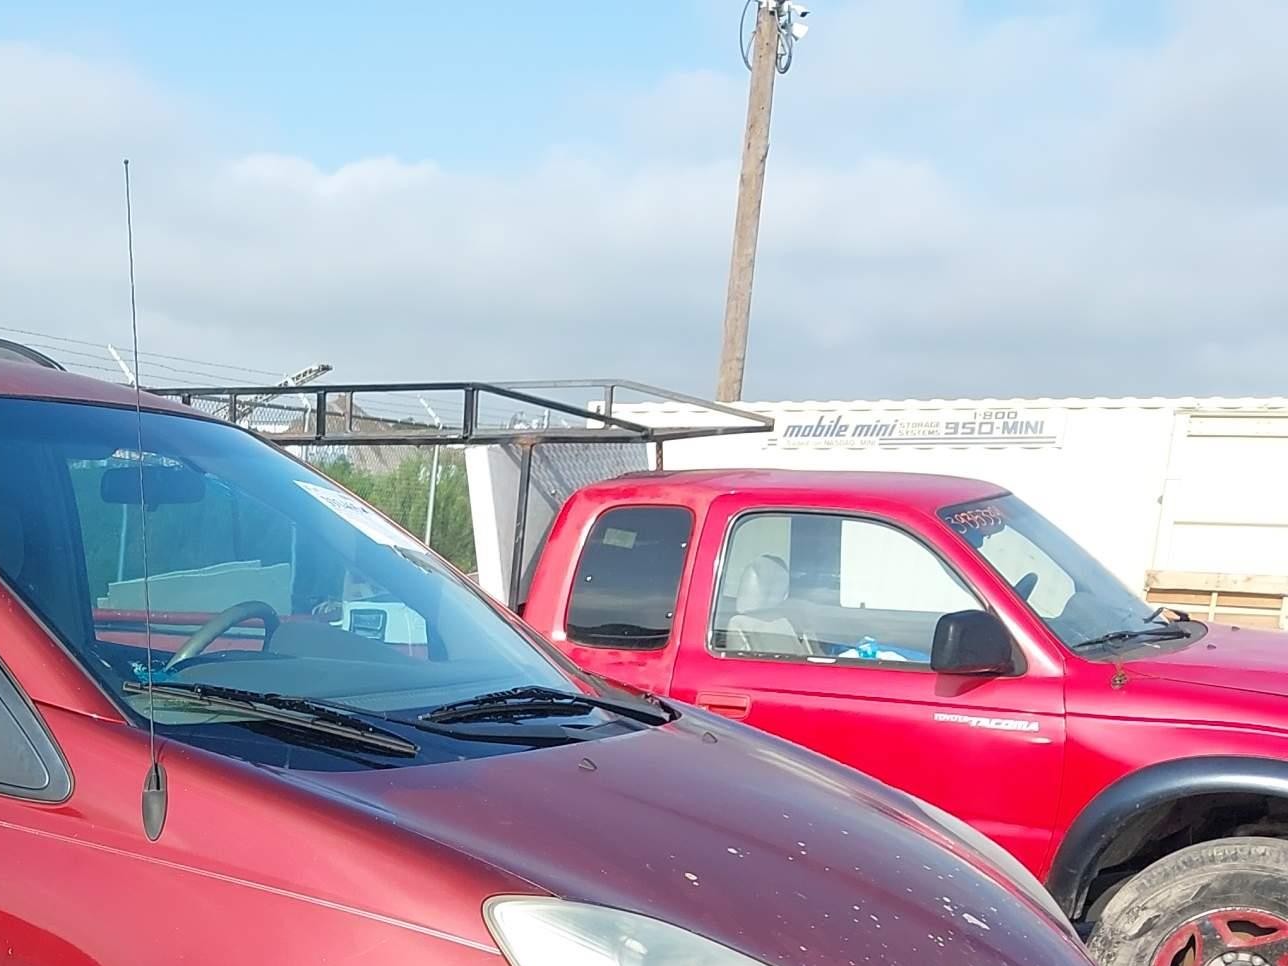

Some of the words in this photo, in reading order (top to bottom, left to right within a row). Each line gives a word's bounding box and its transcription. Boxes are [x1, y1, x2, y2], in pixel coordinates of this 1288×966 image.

[782, 415, 850, 438] mobile
[851, 418, 899, 438] mini
[898, 421, 941, 429] STORAGE
[944, 420, 1045, 436] 950-MINI
[897, 429, 941, 437] SYSTEMS
[968, 717, 1040, 732] TACOMA
